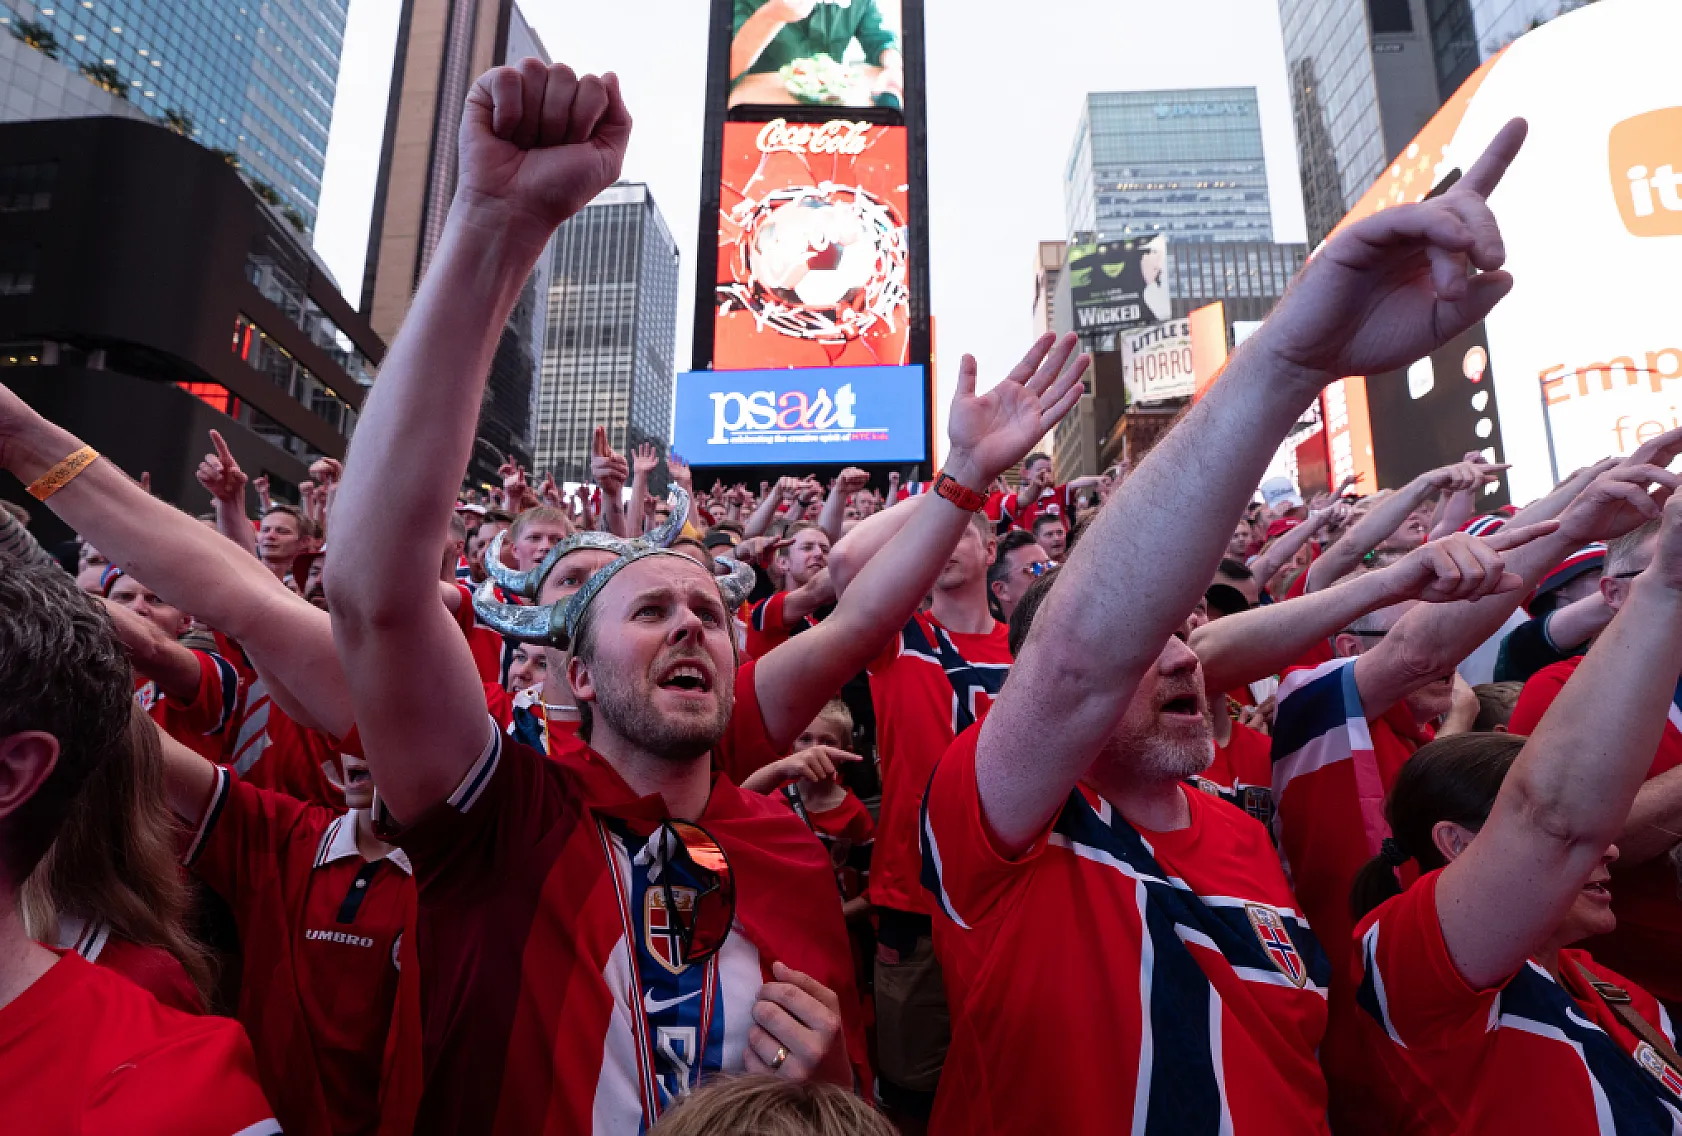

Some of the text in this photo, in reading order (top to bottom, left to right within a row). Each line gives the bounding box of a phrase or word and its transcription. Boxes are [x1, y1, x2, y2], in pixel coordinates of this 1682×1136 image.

[1132, 324, 1177, 354] LITTLE
[707, 382, 857, 445] psart
[306, 929, 374, 948] UMBRO
